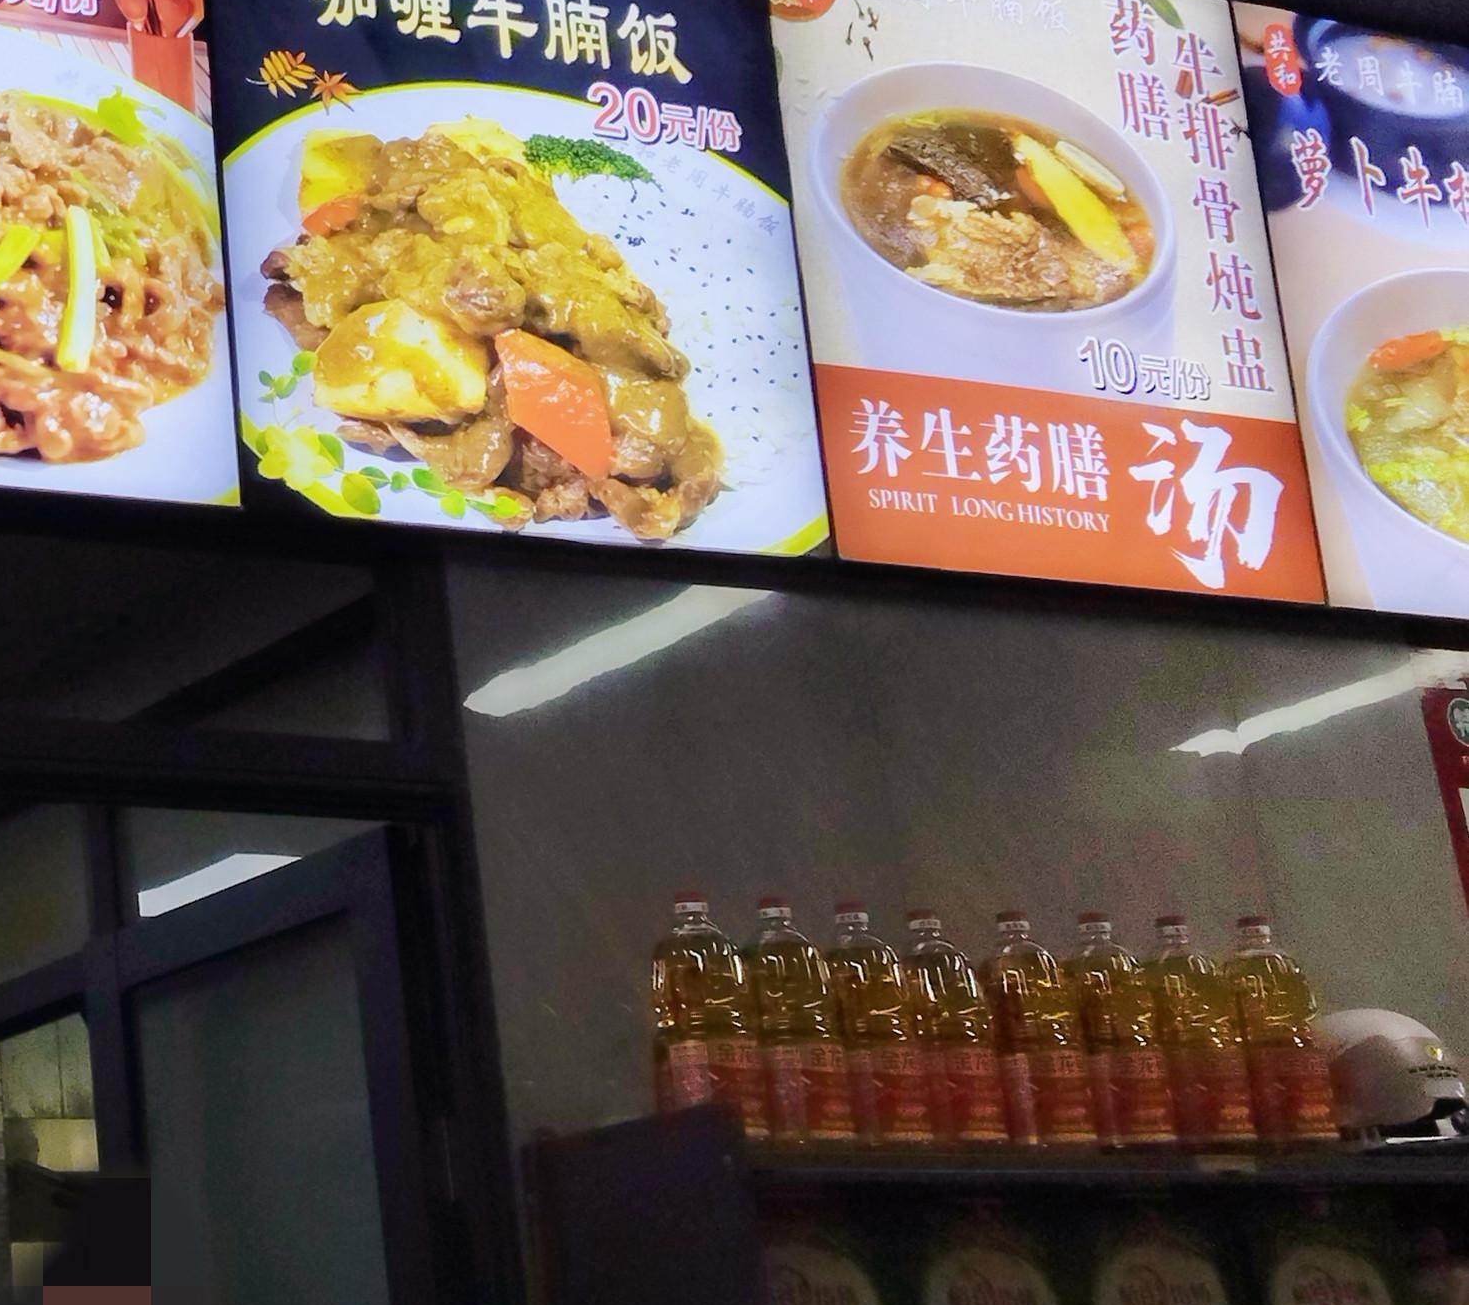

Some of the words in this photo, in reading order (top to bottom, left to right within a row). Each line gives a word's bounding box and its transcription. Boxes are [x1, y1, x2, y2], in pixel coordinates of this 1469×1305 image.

[1267, 30, 1298, 91] 共和
[587, 81, 744, 154] 20元/份
[1078, 335, 1212, 402] 10元/份
[849, 398, 1111, 503] 养生药膳
[868, 487, 939, 515] SPIRIT
[1128, 417, 1286, 590] 汤
